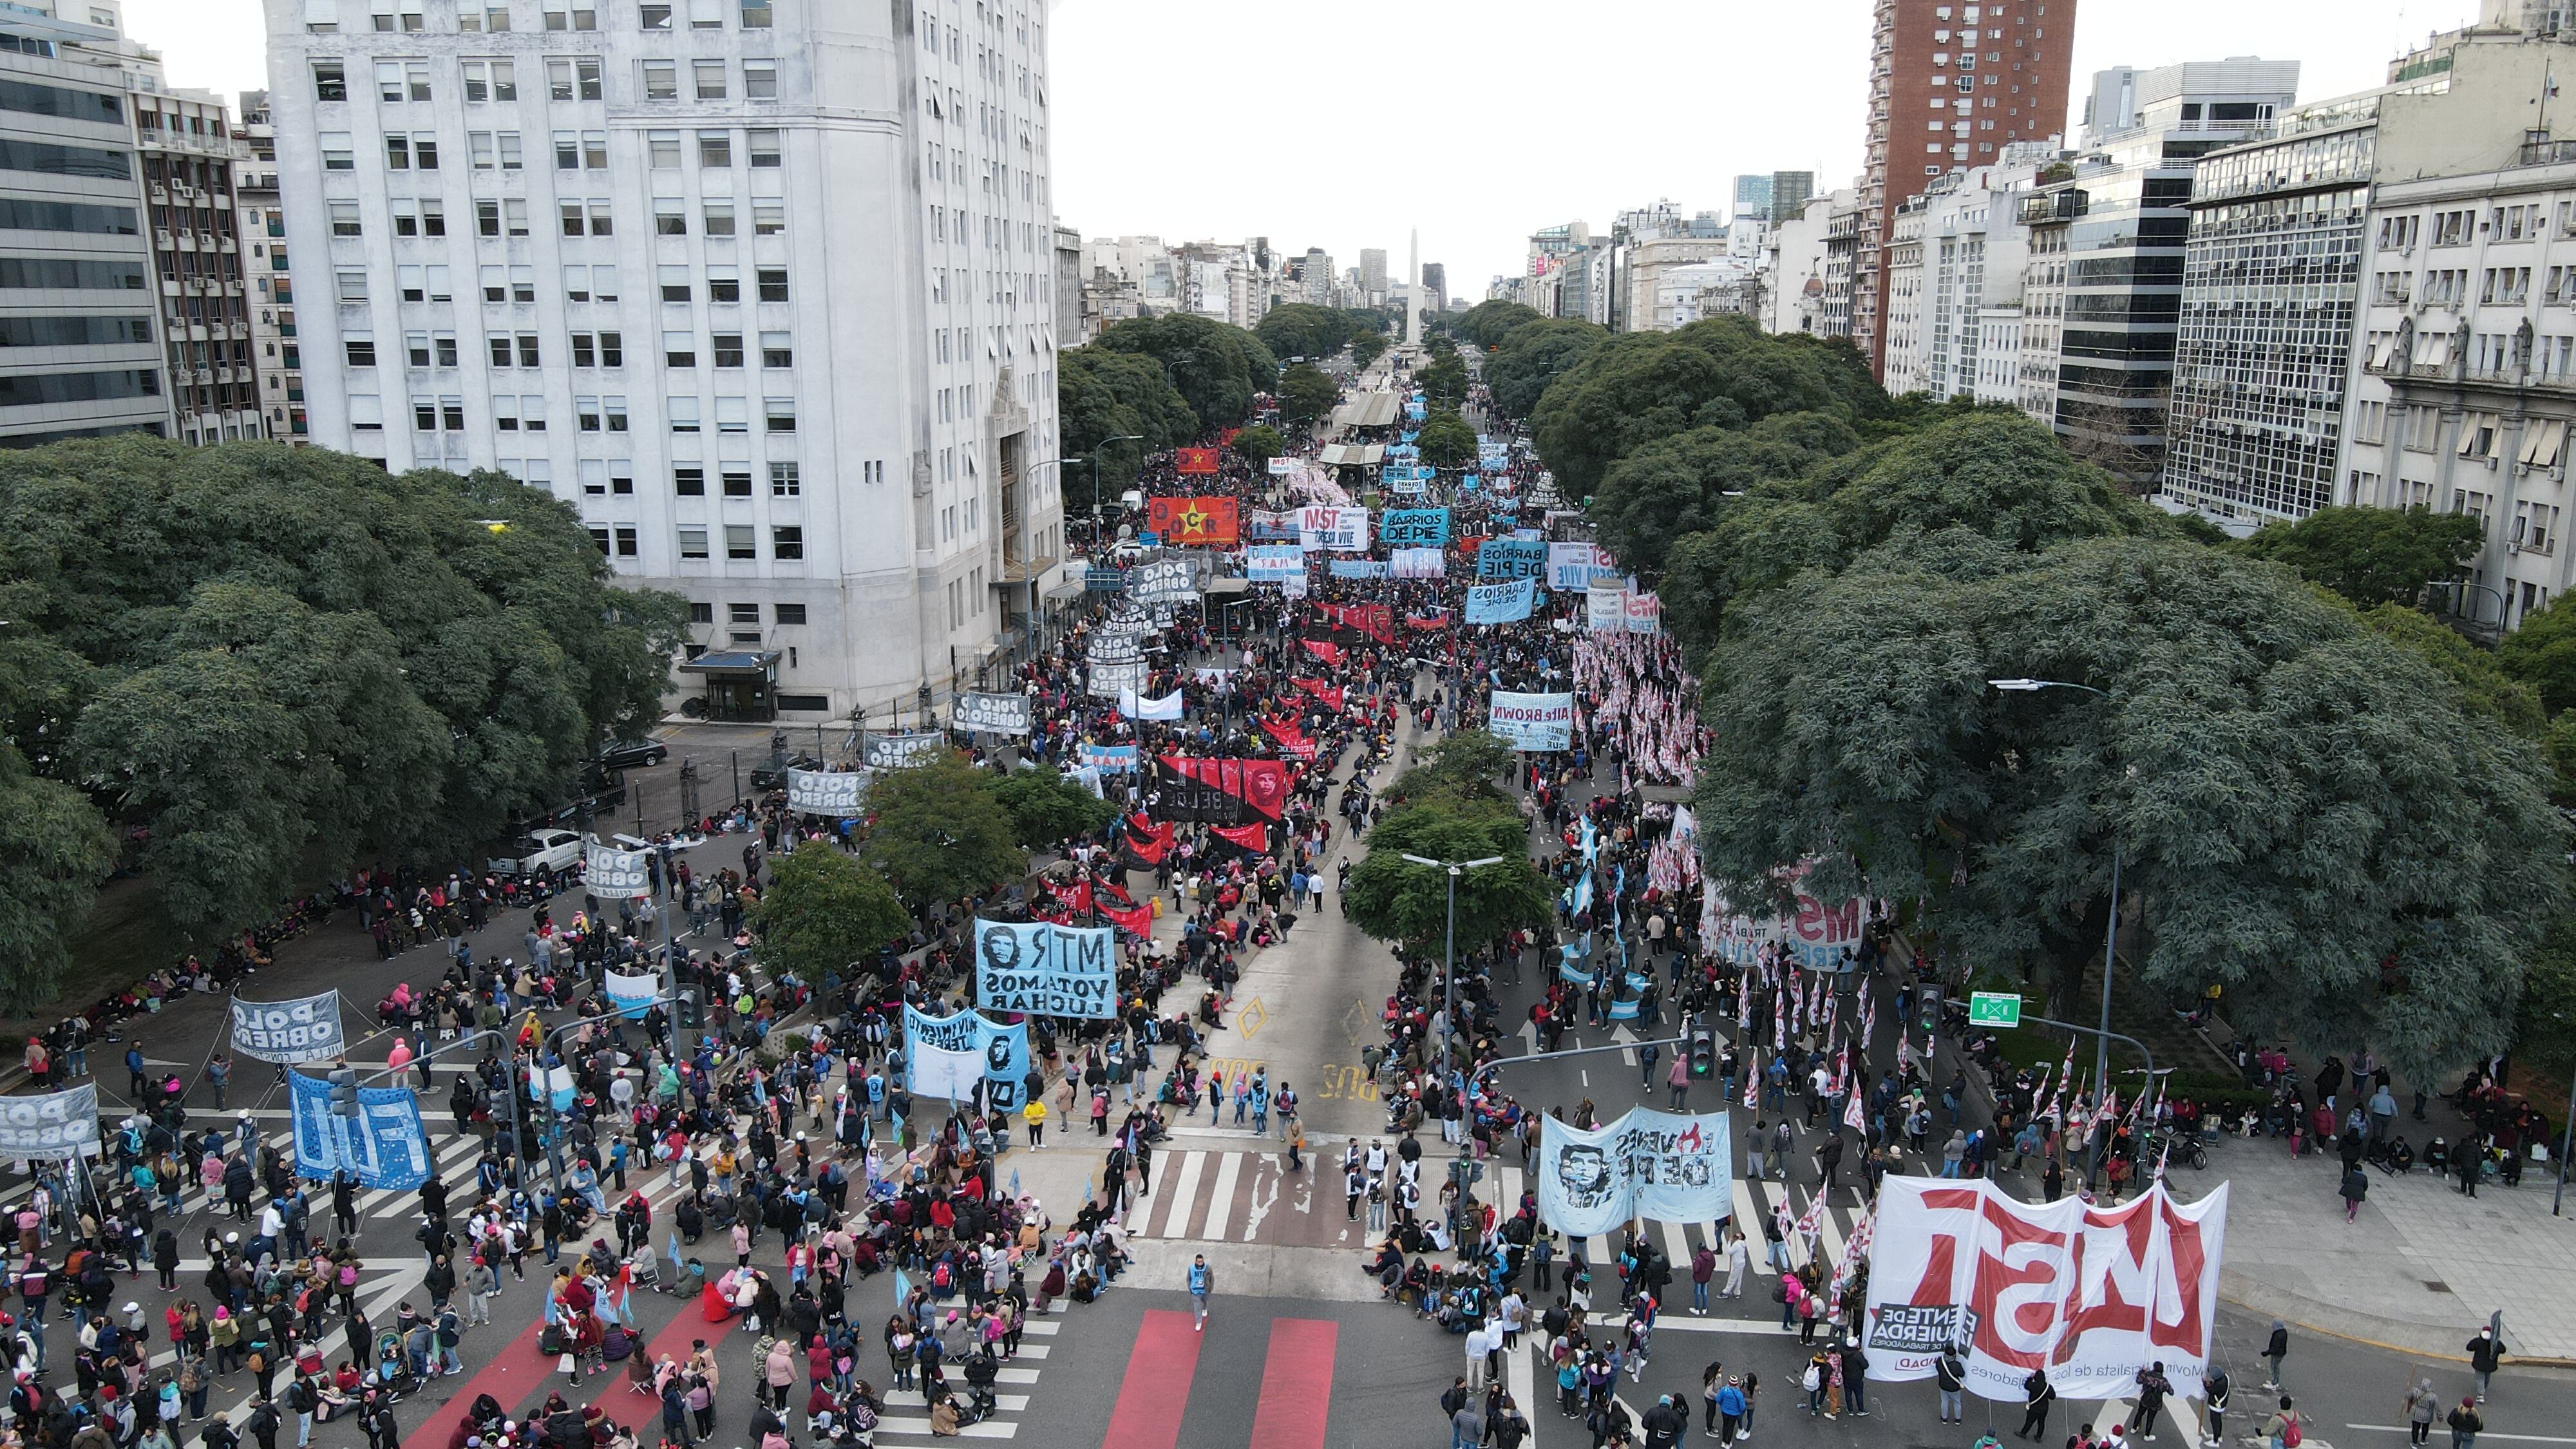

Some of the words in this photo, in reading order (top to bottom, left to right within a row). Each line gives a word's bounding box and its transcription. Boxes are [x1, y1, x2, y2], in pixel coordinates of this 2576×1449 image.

[1305, 509, 1340, 530] MST
[1388, 514, 1442, 526] BARRIOS
[1387, 527, 1408, 540] DE
[1412, 527, 1438, 540] PIE
